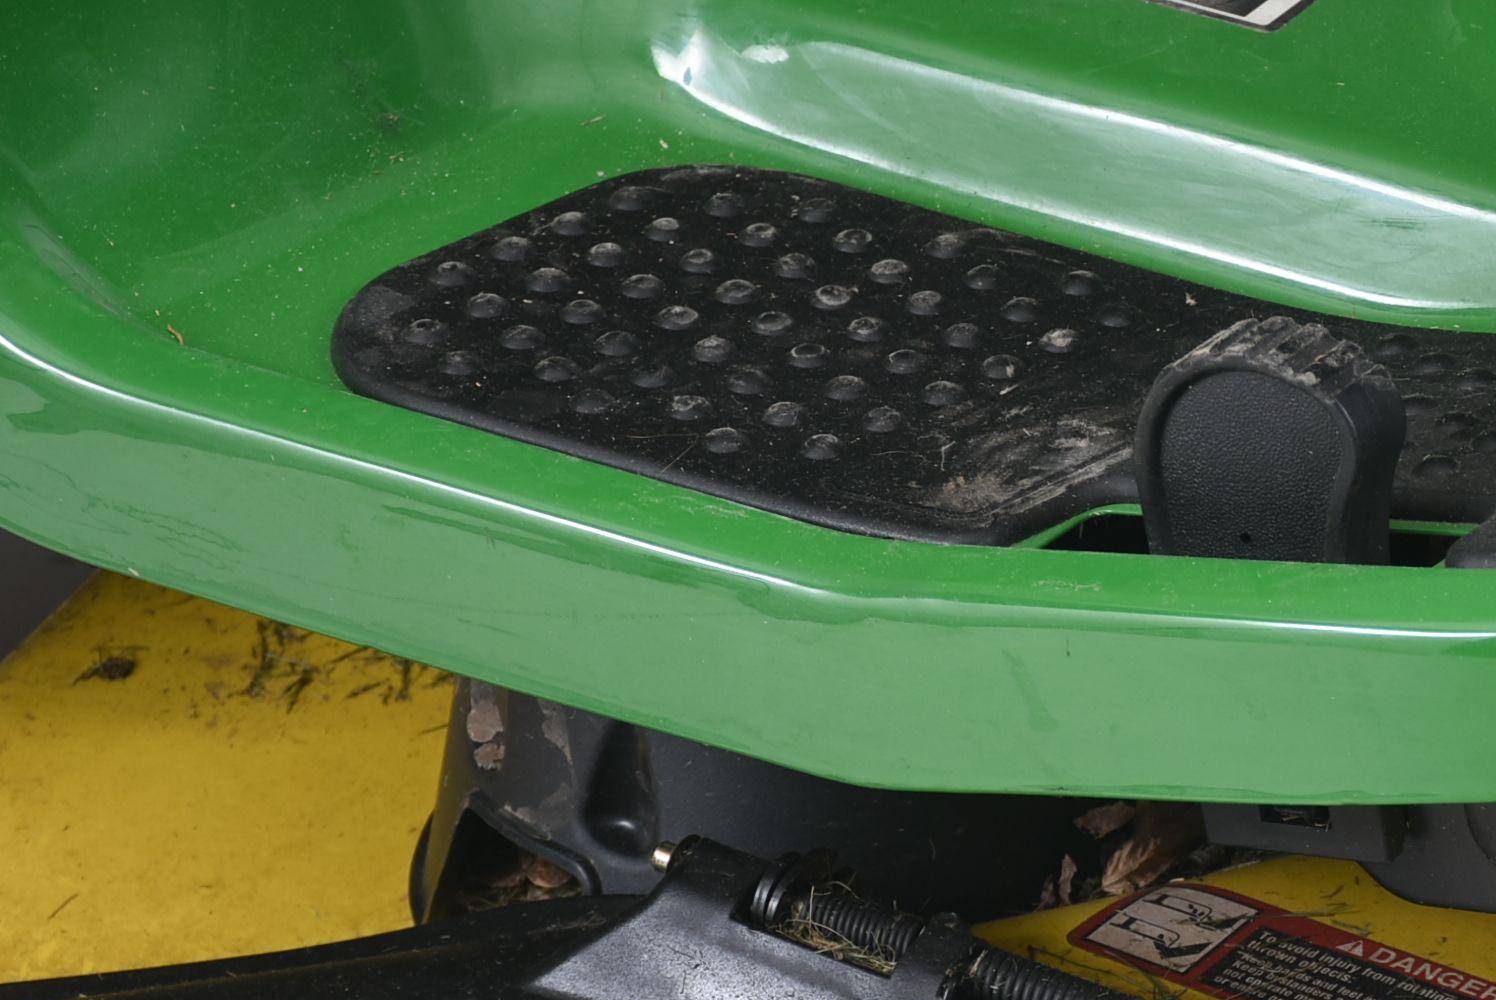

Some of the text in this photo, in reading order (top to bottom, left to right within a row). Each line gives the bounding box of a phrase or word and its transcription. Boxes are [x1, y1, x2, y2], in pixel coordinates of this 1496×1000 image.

[1247, 940, 1297, 964] thrown
[1258, 931, 1277, 943] To
[1320, 953, 1361, 972] injury
[1362, 967, 1396, 985] from
[1222, 968, 1246, 980] not
[1231, 960, 1264, 977] Keep
[1265, 970, 1334, 1000] bstanders
[1312, 977, 1338, 992] and
[1338, 985, 1364, 1000] feet
